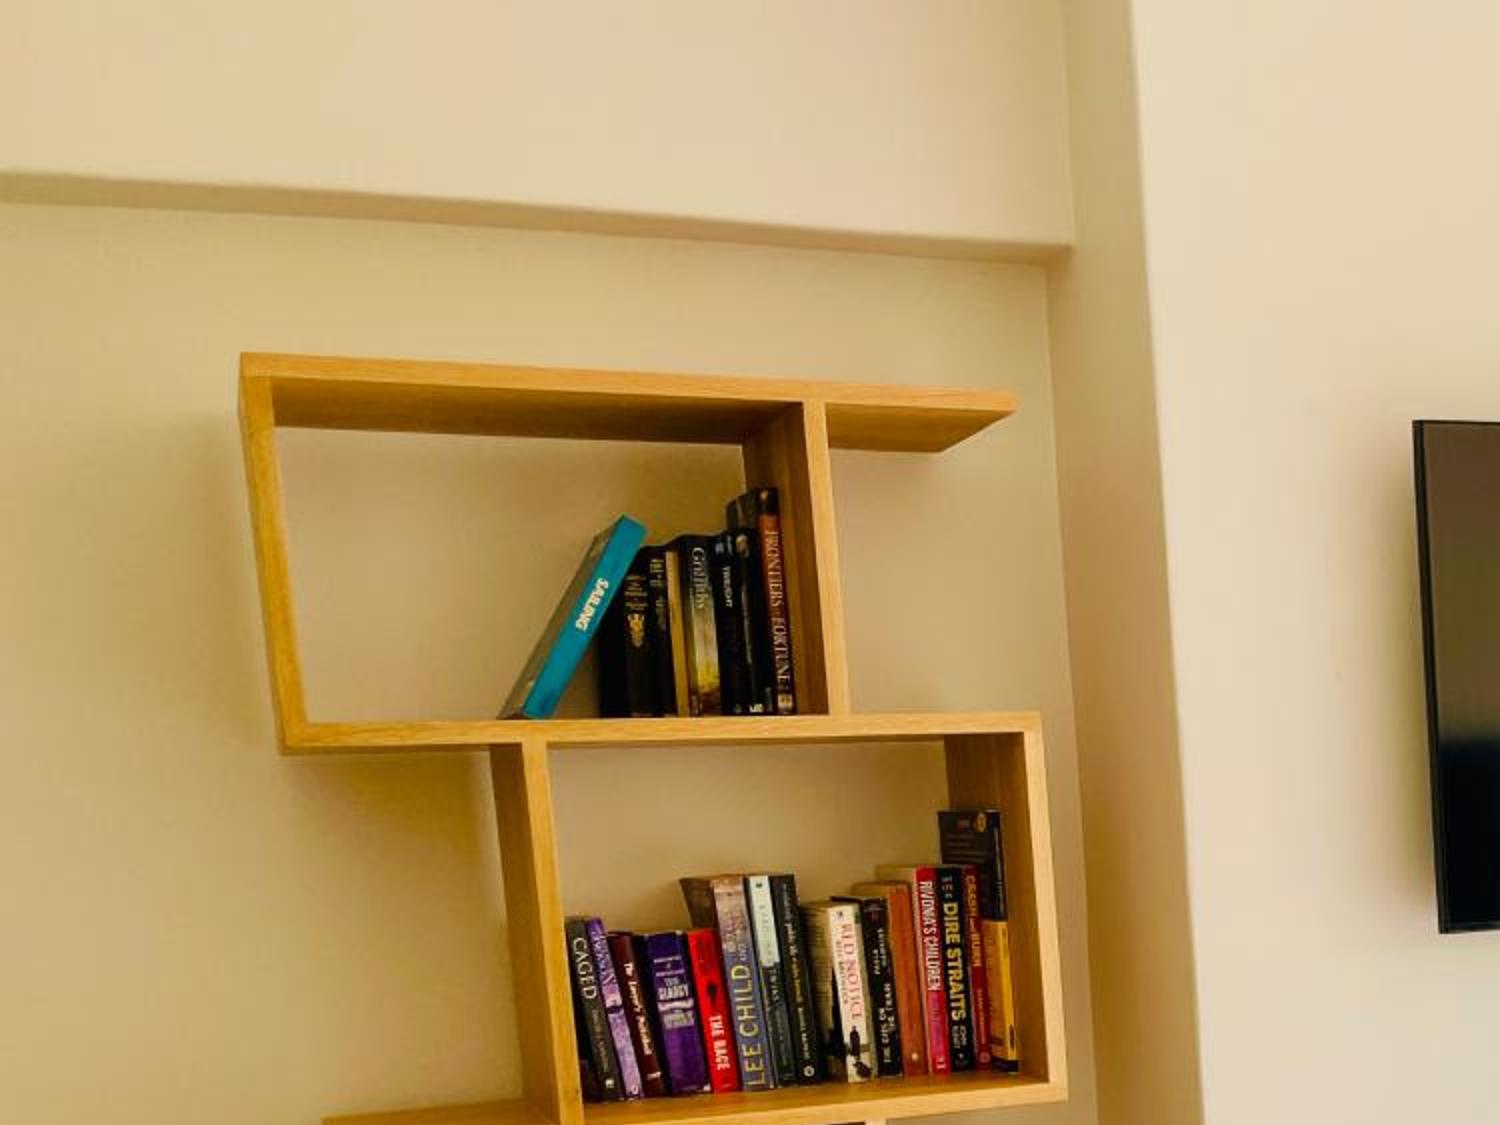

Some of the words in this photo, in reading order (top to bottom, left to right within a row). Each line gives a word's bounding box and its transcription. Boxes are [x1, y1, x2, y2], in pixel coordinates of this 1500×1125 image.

[943, 902, 961, 944] DIRE
[573, 937, 597, 999] CAGED
[924, 937, 943, 991] CHILDREN
[946, 946, 967, 1021] STRAITS
[709, 1015, 726, 1038] THE
[731, 965, 760, 1037] CHILD
[741, 1042, 766, 1086] LEE
